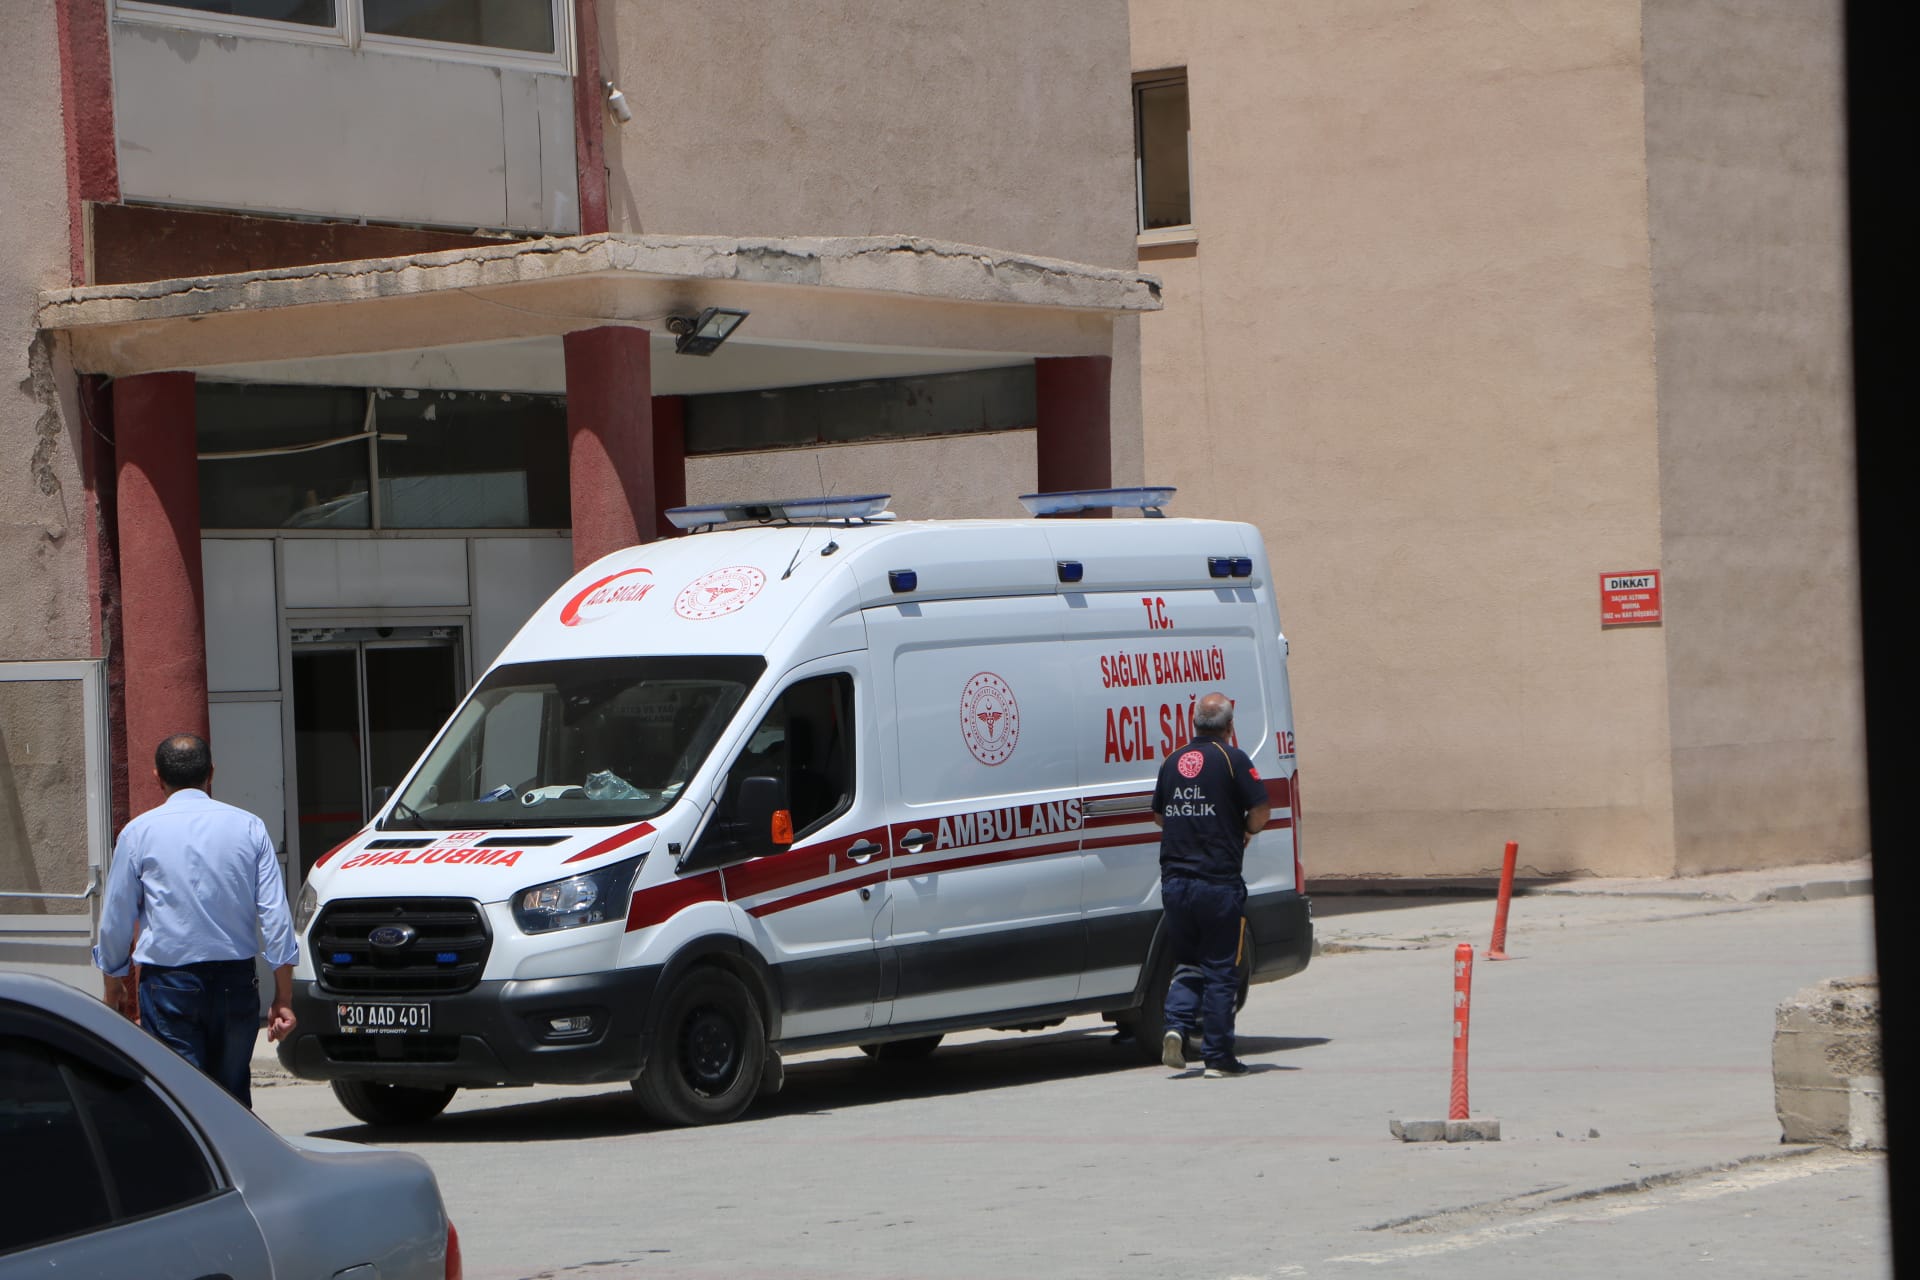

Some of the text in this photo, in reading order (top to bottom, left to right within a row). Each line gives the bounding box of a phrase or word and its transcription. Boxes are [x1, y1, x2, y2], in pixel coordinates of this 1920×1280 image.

[1611, 578, 1649, 589] DİKKAT
[1142, 597, 1174, 629] T.C.
[1101, 645, 1226, 688] SAĞLIK BAKANLIĞI
[1276, 731, 1295, 754] 112
[1173, 785, 1206, 800] ACİL
[1165, 802, 1216, 817] SAĞLIK
[936, 800, 1083, 850] AMBULANS
[347, 1006, 426, 1026] 30 AAD 401
